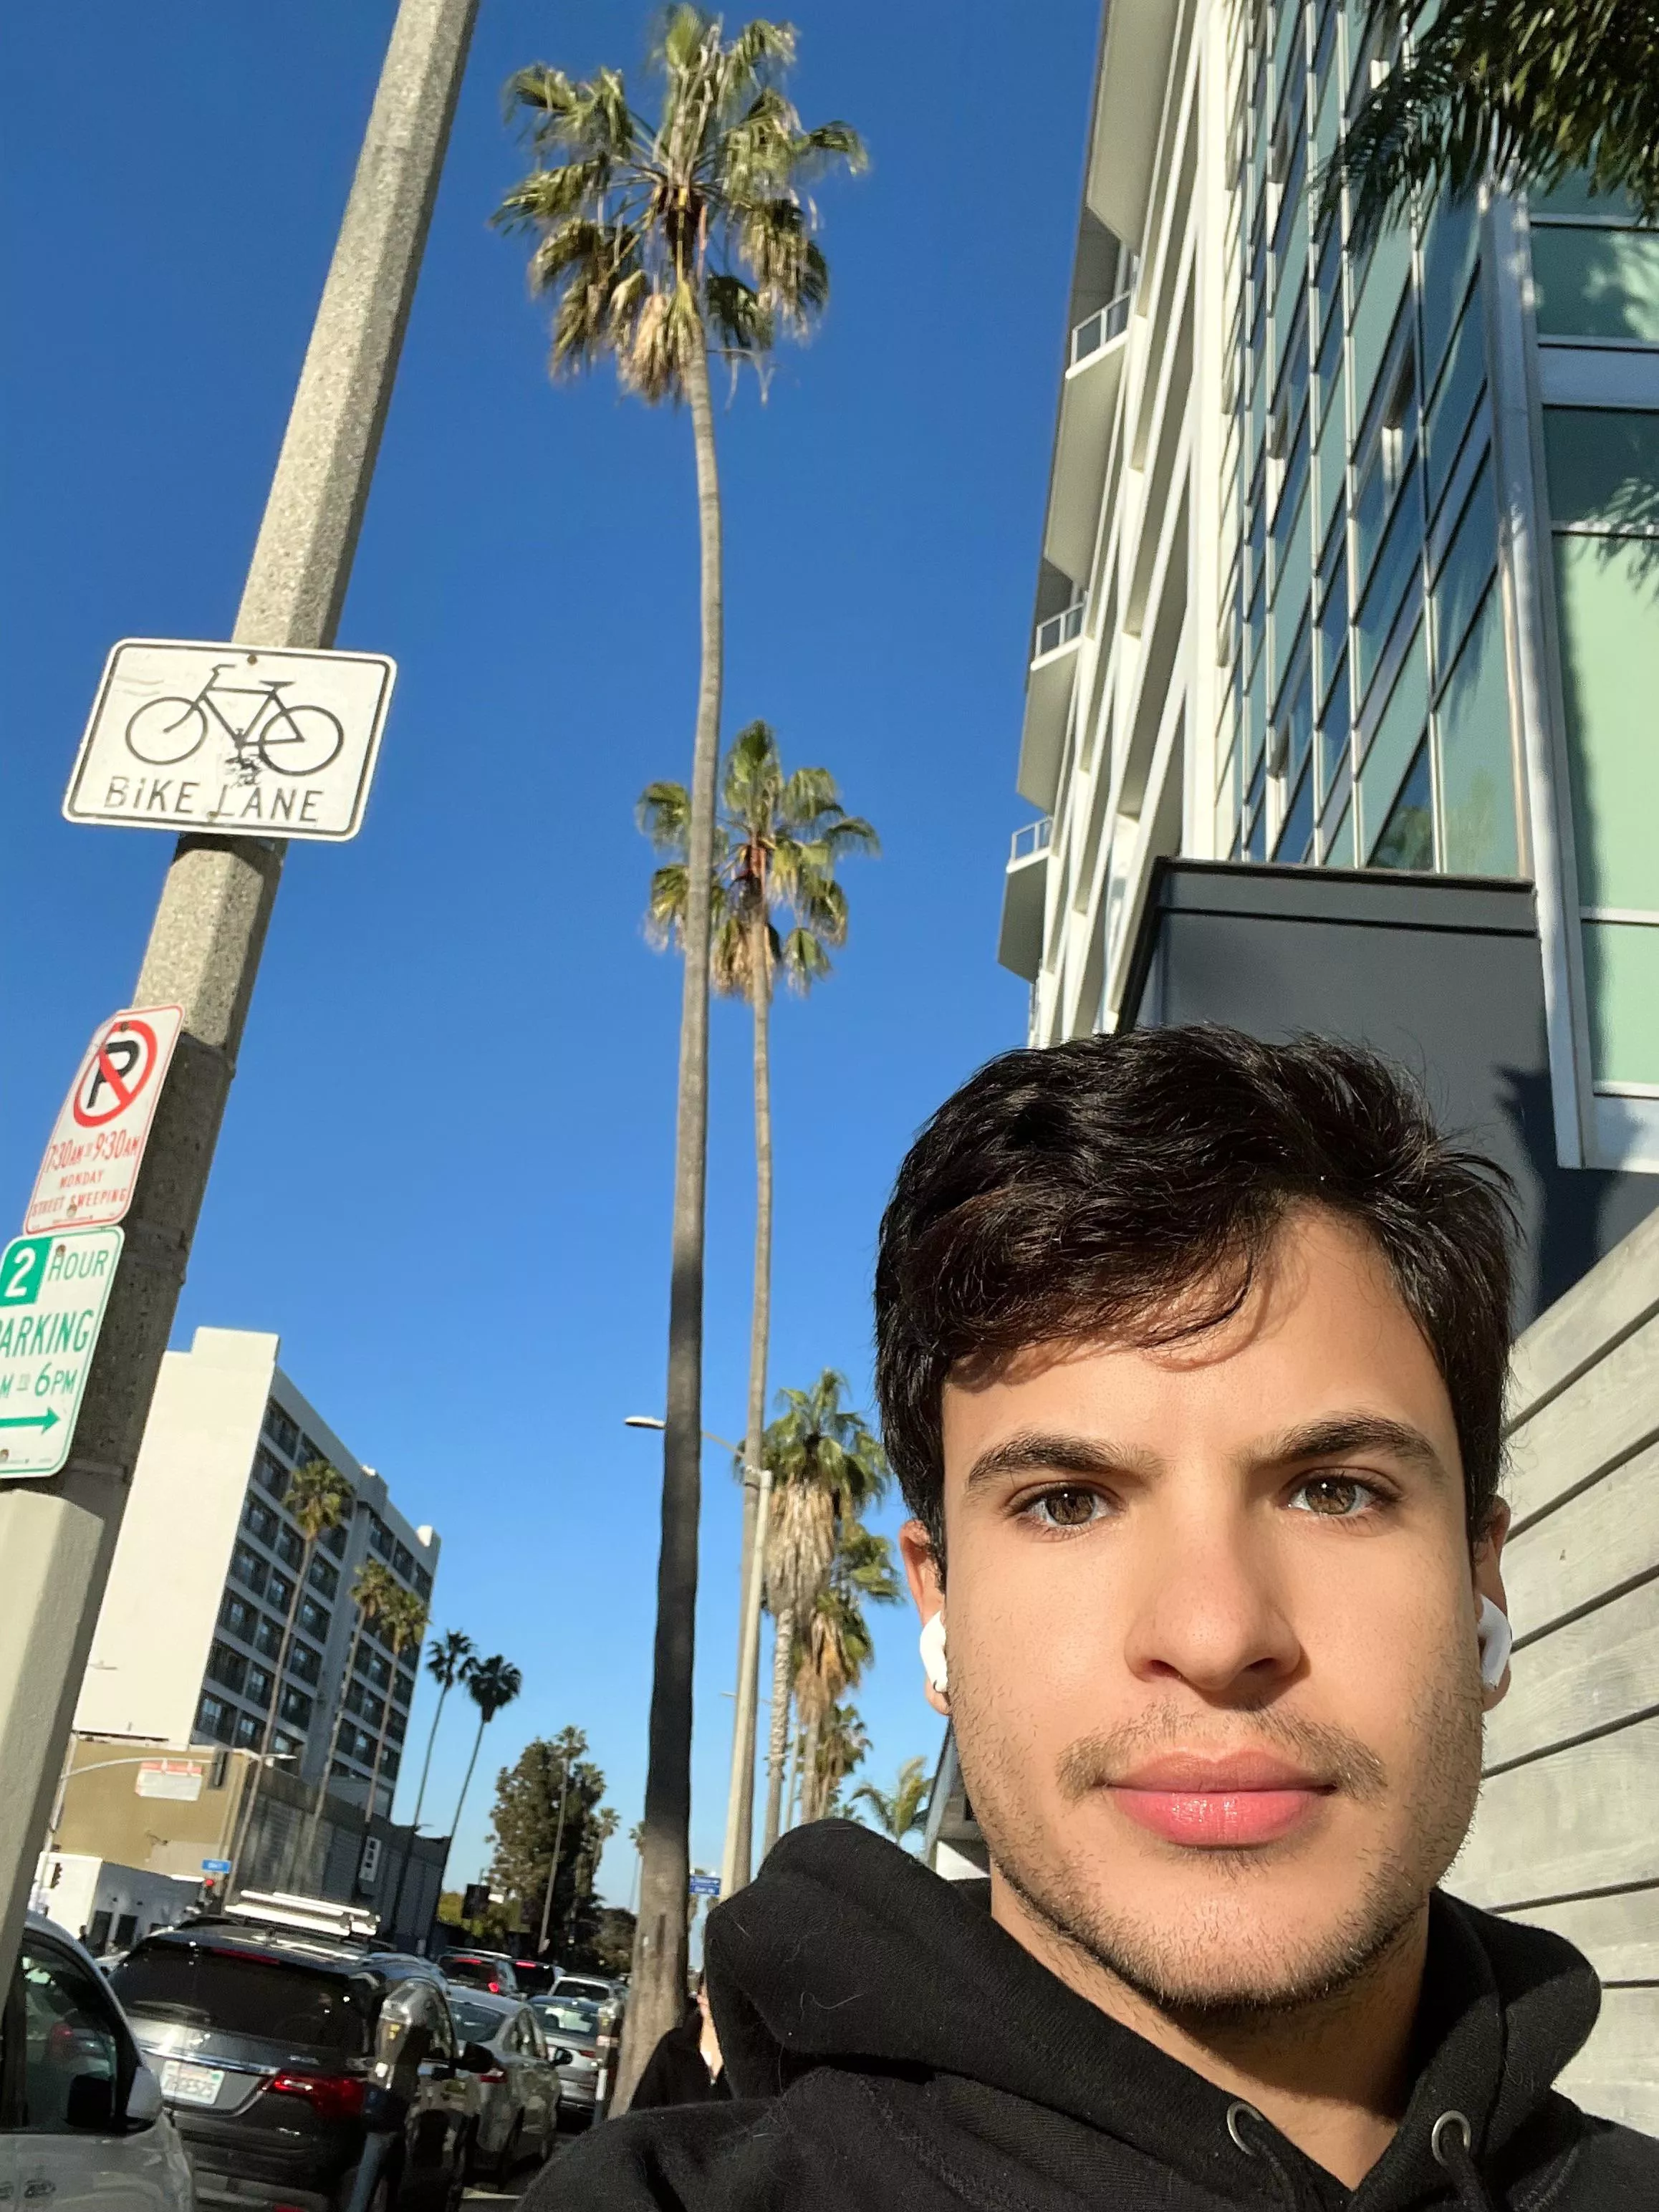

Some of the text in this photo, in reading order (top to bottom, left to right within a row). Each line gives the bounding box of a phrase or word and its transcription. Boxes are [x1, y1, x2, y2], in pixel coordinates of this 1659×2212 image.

[104, 776, 325, 824] BIKE LANE
[59, 1169, 104, 1189] MONDAY
[4, 1246, 109, 1298] 2 HOUR
[34, 1361, 78, 1397] 6PM
